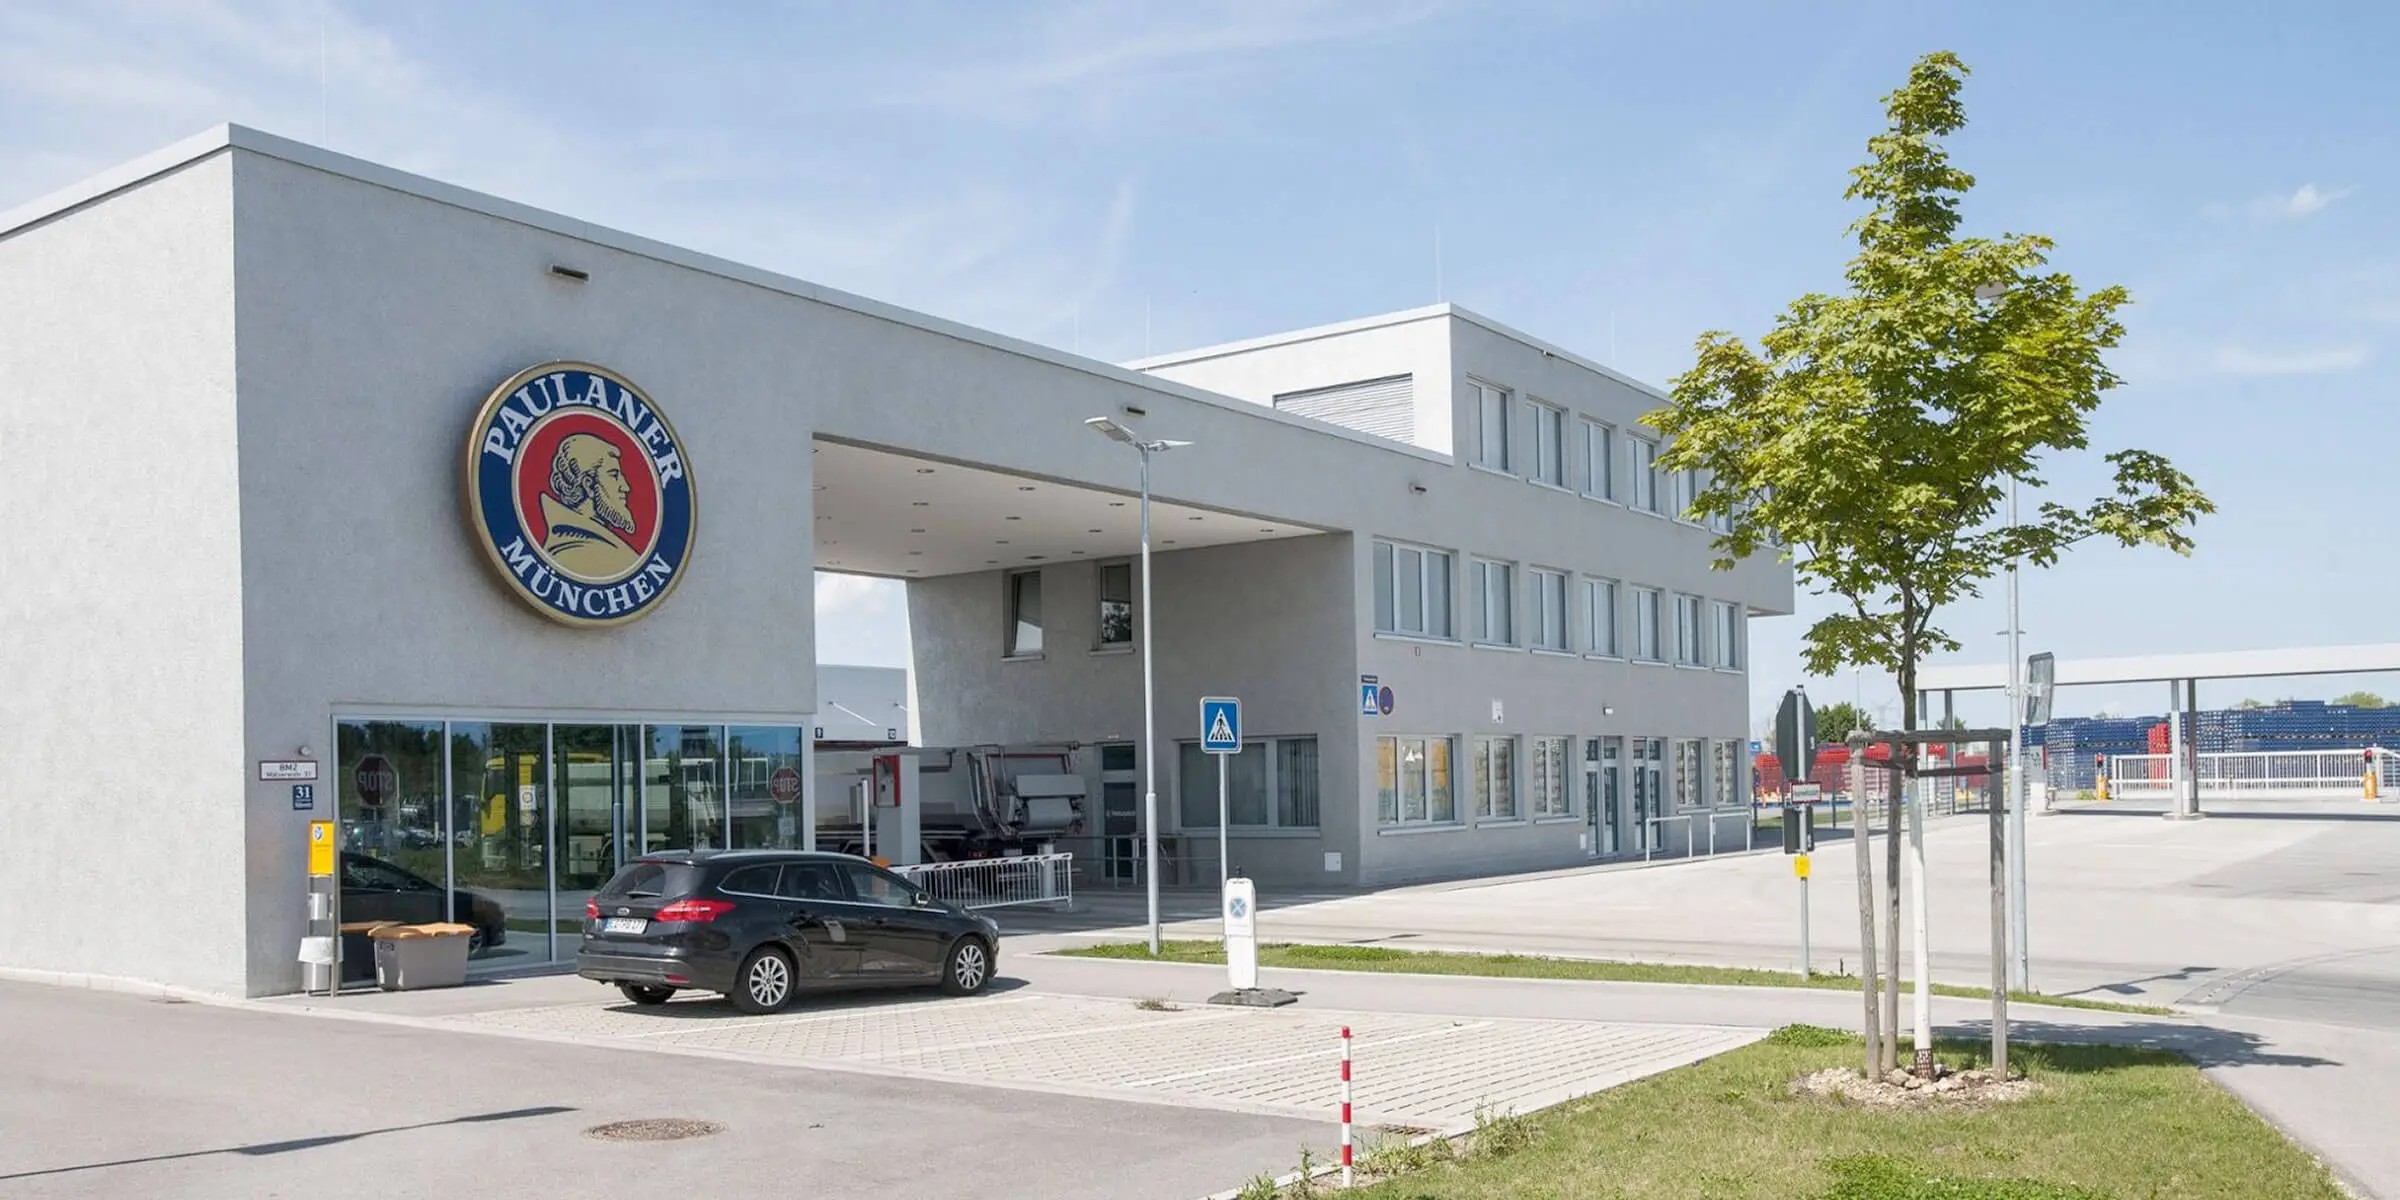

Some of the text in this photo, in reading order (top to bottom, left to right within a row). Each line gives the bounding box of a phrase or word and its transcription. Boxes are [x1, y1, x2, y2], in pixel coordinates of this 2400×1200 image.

[484, 373, 682, 489] PAULANER
[501, 536, 672, 616] MÜNCHEN
[295, 786, 311, 798] 31
